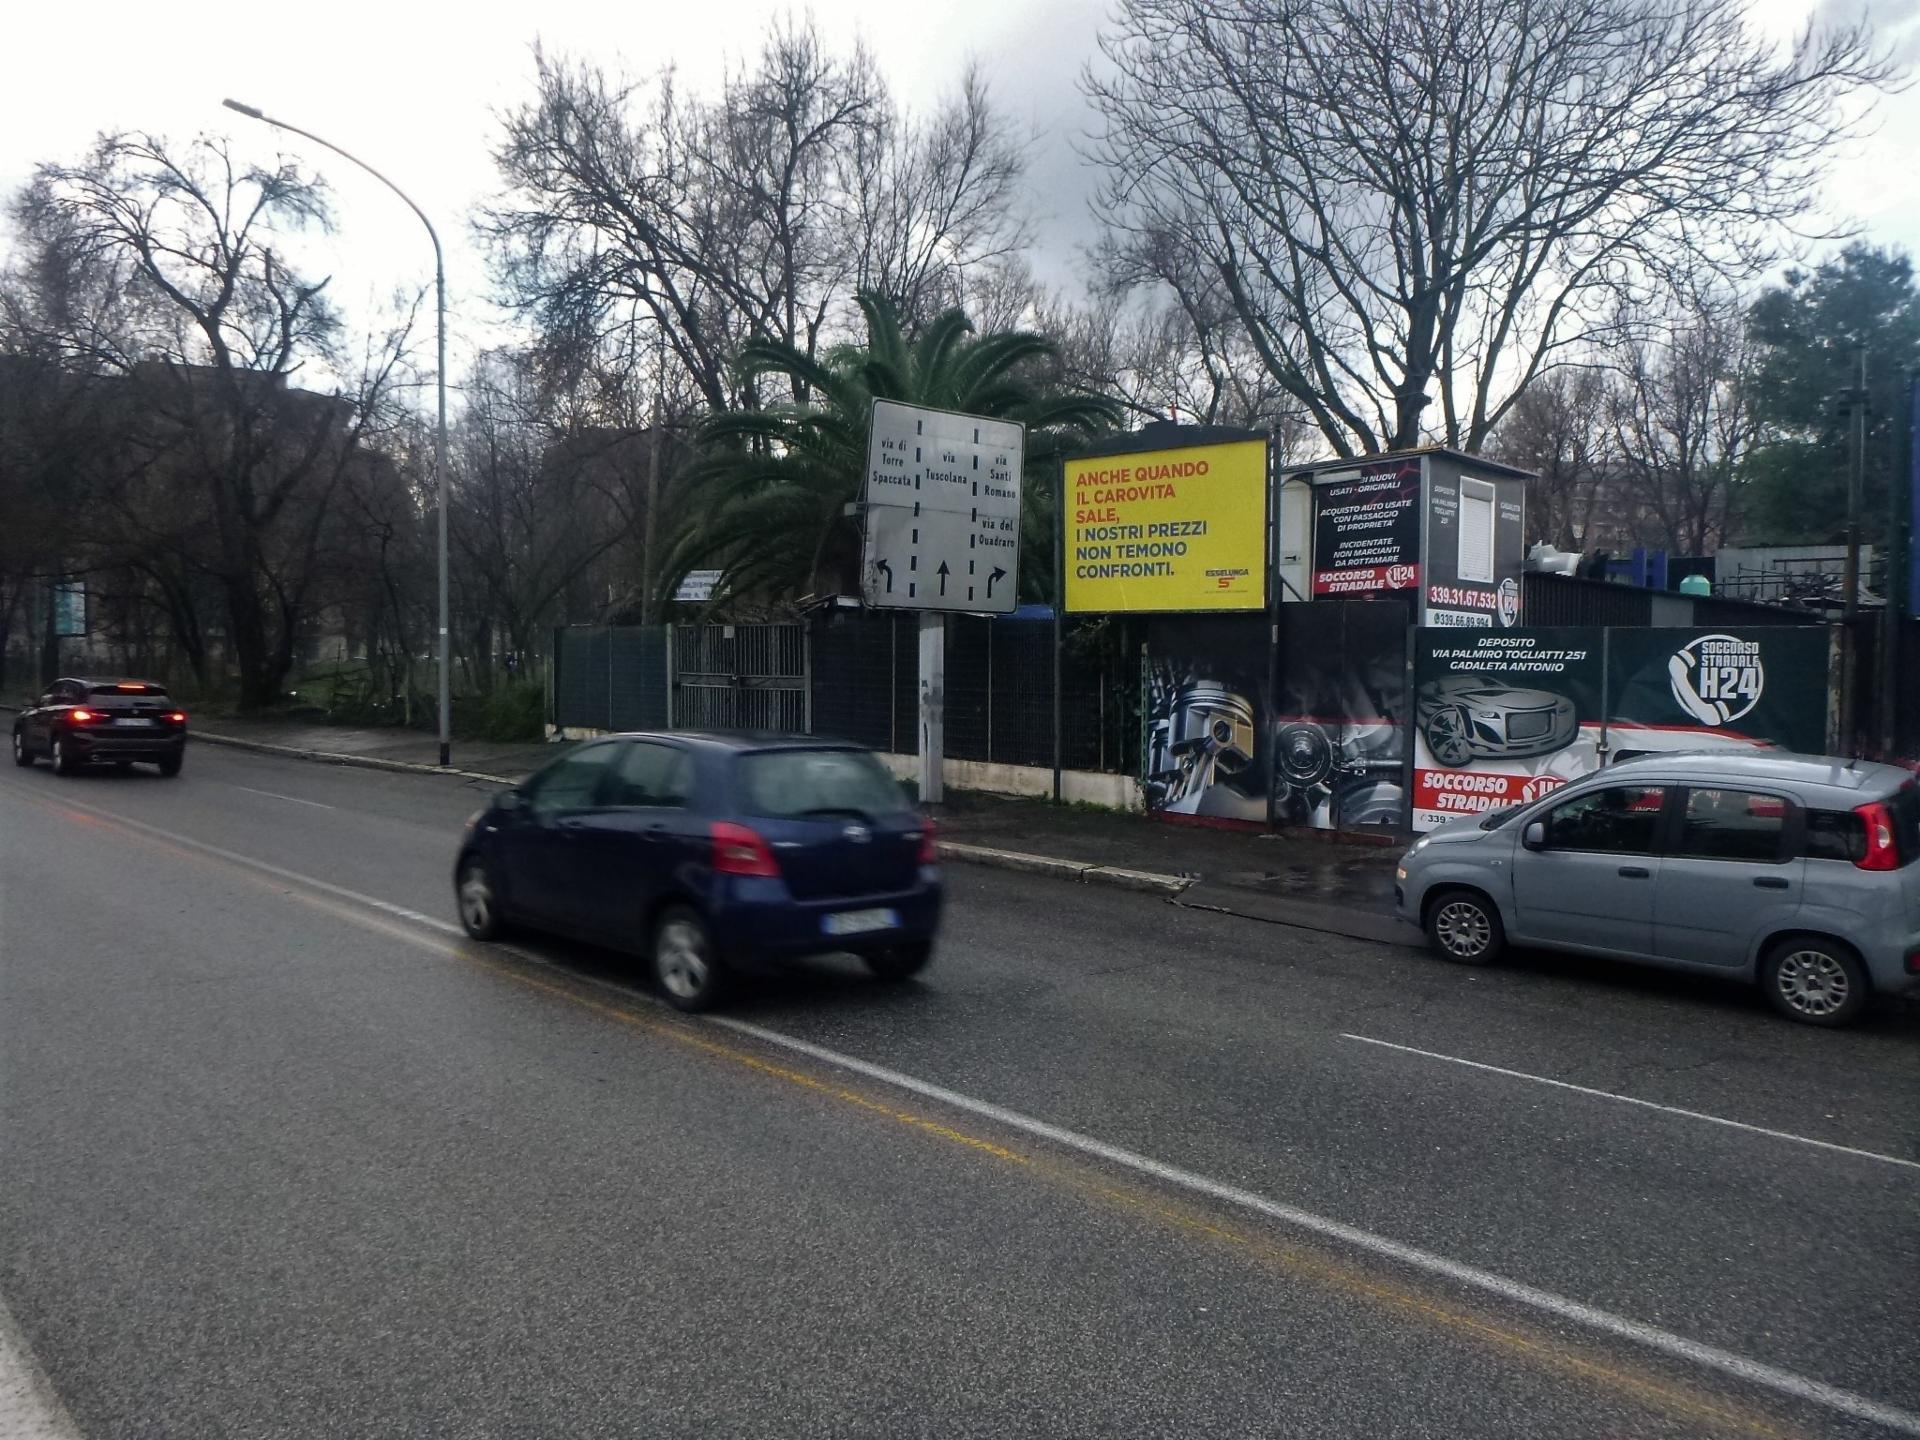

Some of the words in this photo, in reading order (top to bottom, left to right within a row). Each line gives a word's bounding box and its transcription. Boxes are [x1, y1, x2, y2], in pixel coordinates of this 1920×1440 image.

[881, 437, 894, 449] via
[898, 440, 907, 451] di
[882, 453, 904, 467] Torre
[943, 451, 955, 463] via
[995, 454, 1007, 466] via
[873, 470, 911, 486] Spaccata
[925, 468, 967, 484] Tuscolana
[990, 469, 1012, 482] Santi
[1076, 468, 1130, 487] ANCHE
[1135, 461, 1209, 482] QUANDO
[1369, 473, 1396, 483] NUOVI
[984, 485, 1016, 499] Romano
[1077, 491, 1090, 505] IL
[1094, 483, 1175, 503] CAROVITA
[1329, 487, 1352, 496] USATI
[1358, 481, 1401, 493] ORIGINALI
[1321, 505, 1360, 517] ACQUISTO
[1361, 502, 1383, 511] AUTO
[1385, 499, 1412, 510] USATE
[1076, 508, 1120, 524] SALE,
[1333, 515, 1351, 523] CON
[1352, 510, 1399, 521] PASSAGGIO
[982, 518, 995, 529] via
[1000, 519, 1013, 531] del
[1076, 529, 1081, 542] I
[1085, 525, 1144, 541] NOSTRI
[1148, 520, 1207, 537] PREZZI
[1339, 537, 1394, 549] INCIDENTATE
[1076, 546, 1111, 560] NON
[1116, 541, 1187, 559] TEMONO
[1333, 550, 1353, 559] NON
[1353, 546, 1401, 557] MARCIANTI
[1335, 559, 1347, 567] DA
[1347, 555, 1399, 566] ROTTAMARE
[1076, 562, 1175, 579] CONFRONTI.
[1318, 569, 1376, 583] SOCCORSO
[1393, 566, 1415, 581] H24
[1328, 579, 1385, 593] STRADALE
[1431, 586, 1496, 609] 339.31.67.532
[1477, 638, 1536, 647] DEPOSITO
[1701, 641, 1759, 654] SOCCORSO
[1432, 649, 1450, 658] VIA
[1451, 649, 1503, 659] PALMIRO
[1505, 650, 1564, 660] TOGLIATTI
[1565, 651, 1587, 660] 251
[1701, 654, 1759, 667] STRADALE
[1509, 662, 1565, 672] ANTONIO
[1700, 667, 1759, 700] H24
[1422, 772, 1508, 793] SOCCORSO
